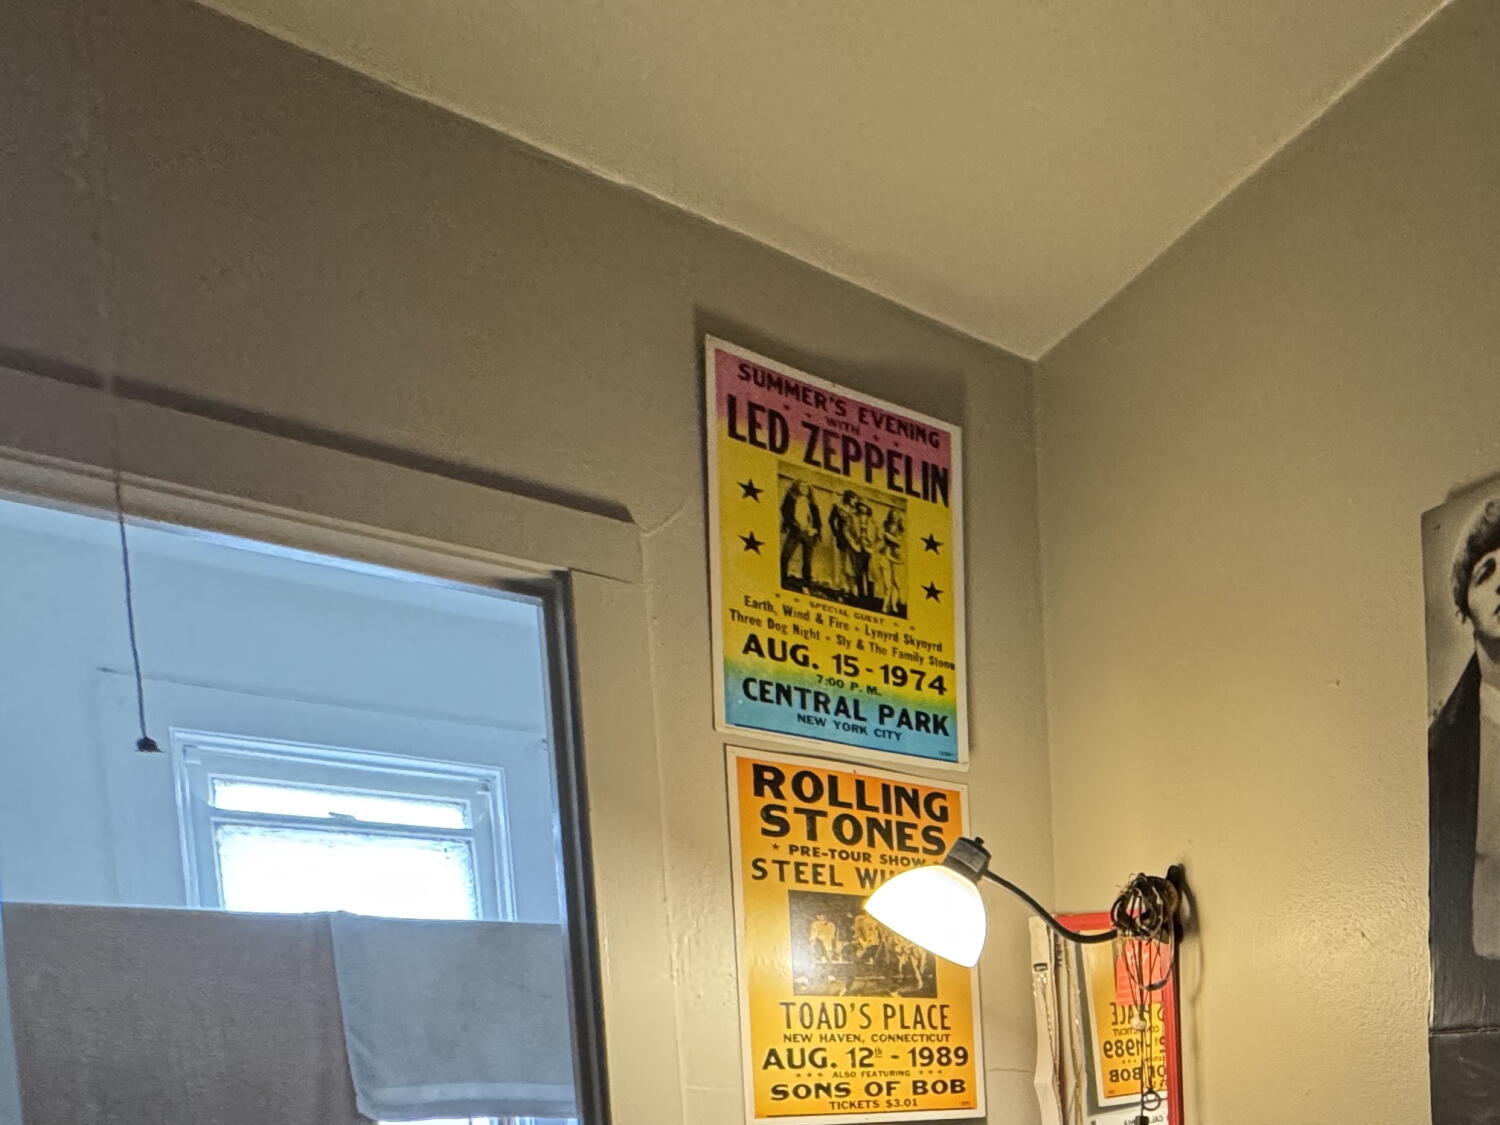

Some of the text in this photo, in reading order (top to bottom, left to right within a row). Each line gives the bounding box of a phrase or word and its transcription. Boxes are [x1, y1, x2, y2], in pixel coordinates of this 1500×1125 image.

[738, 362, 940, 448] SUMMER'S EVENING
[824, 416, 860, 436] WITH
[726, 394, 949, 508] LED ZEPPELIN
[744, 595, 943, 652] Earth, Wind & Fire Lynyrd Skynyrd
[809, 601, 886, 625] SPECIAL GUEST
[728, 608, 956, 671] Three Dog Night Sly & The Family Stone
[742, 633, 820, 670] AUG.
[816, 674, 844, 690] 7:00
[742, 677, 950, 736] CENTRAL PARK
[797, 713, 902, 742] NEW YORK CITY
[752, 763, 949, 823] ROLLING
[760, 804, 946, 856] STONES
[788, 844, 926, 867] PRE-TOUR SHOW
[751, 858, 844, 888] STEEL
[780, 1002, 951, 1030] TOAD'S PLACE
[783, 1033, 950, 1044] NEW HAVEN, CONNECTICUT
[762, 1048, 838, 1071] AUG.
[908, 1046, 969, 1068] 1989
[832, 1070, 911, 1078] ALSO FEATURING
[770, 1078, 966, 1101] SONS OF BOB
[829, 1098, 918, 1111] TICKETS $3.01
